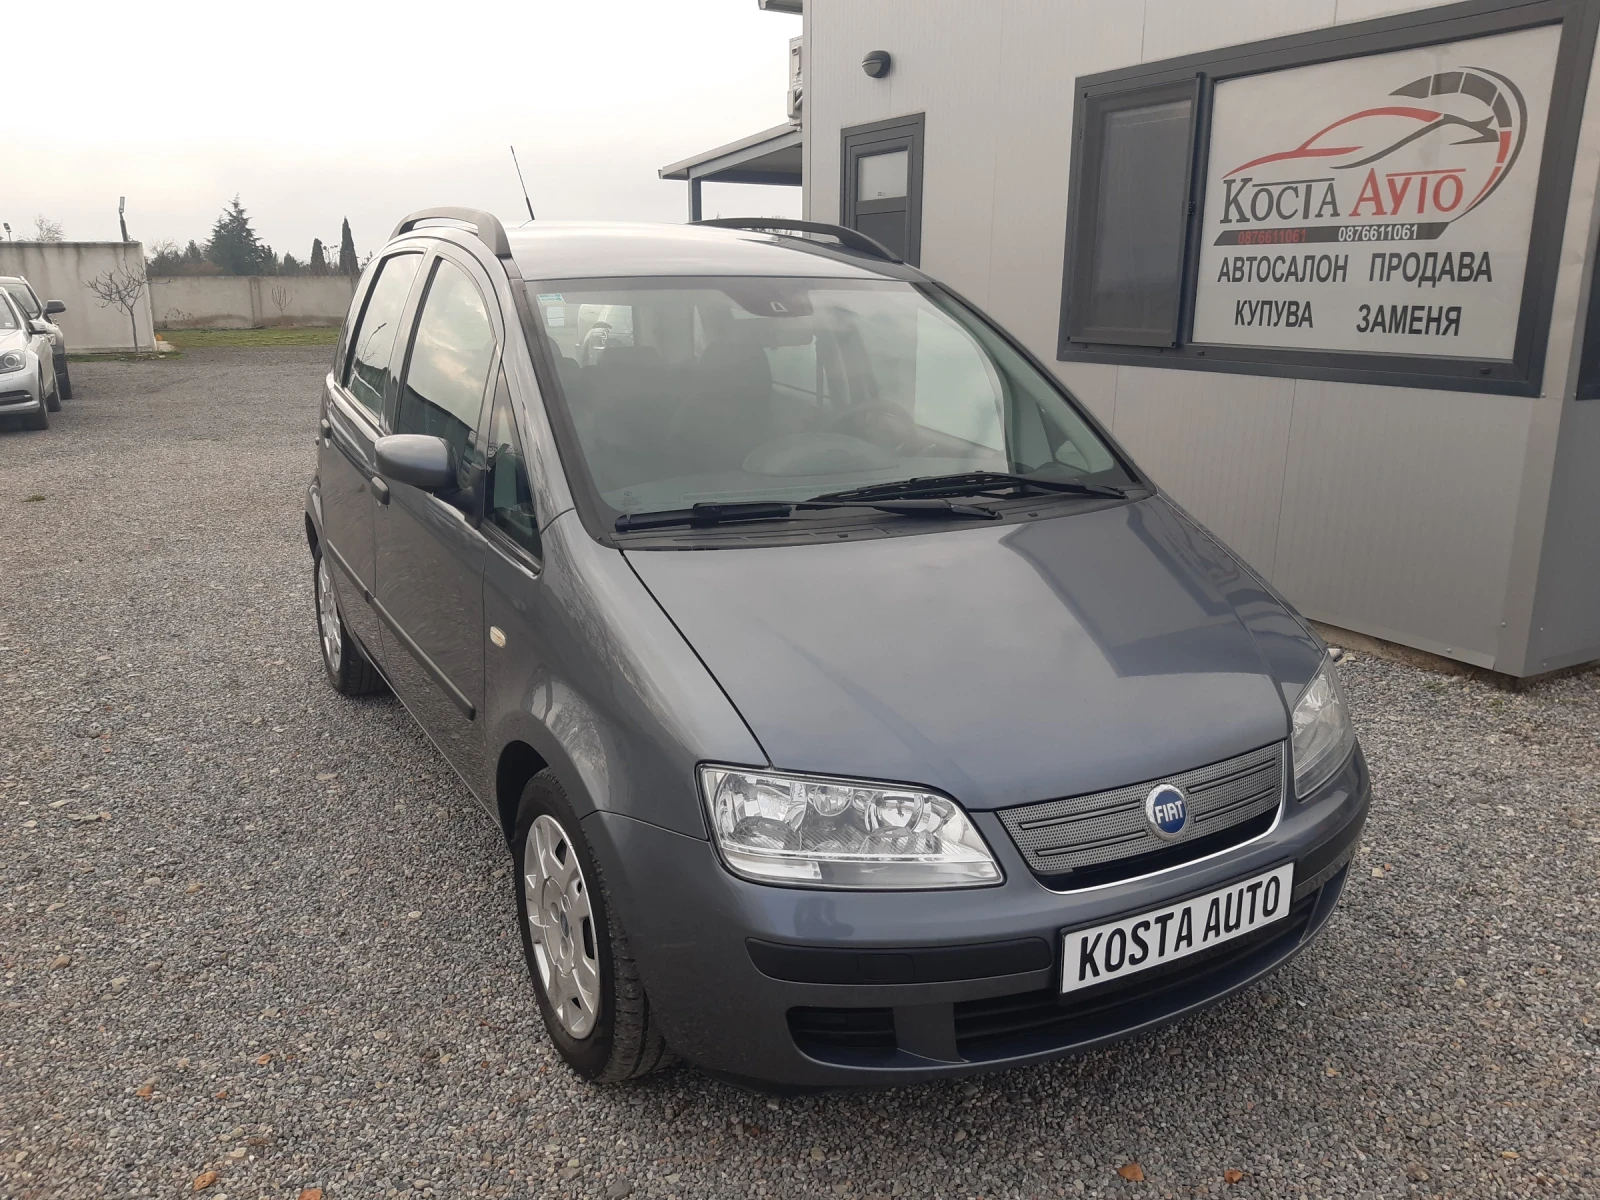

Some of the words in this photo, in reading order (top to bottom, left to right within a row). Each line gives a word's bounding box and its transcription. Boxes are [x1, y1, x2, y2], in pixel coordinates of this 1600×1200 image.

[1238, 228, 1307, 244] 0876611061
[1338, 224, 1419, 241] 0876611061
[1217, 254, 1349, 283] АВТОСАЛОН
[1368, 251, 1493, 288] ПРОДАВА
[1234, 299, 1314, 328] КУПУВА
[1355, 303, 1462, 337] ЗАМЕНЯ
[1153, 800, 1184, 824] FIAT
[1078, 906, 1193, 982] KOSTA
[1202, 875, 1281, 943] AUTO
